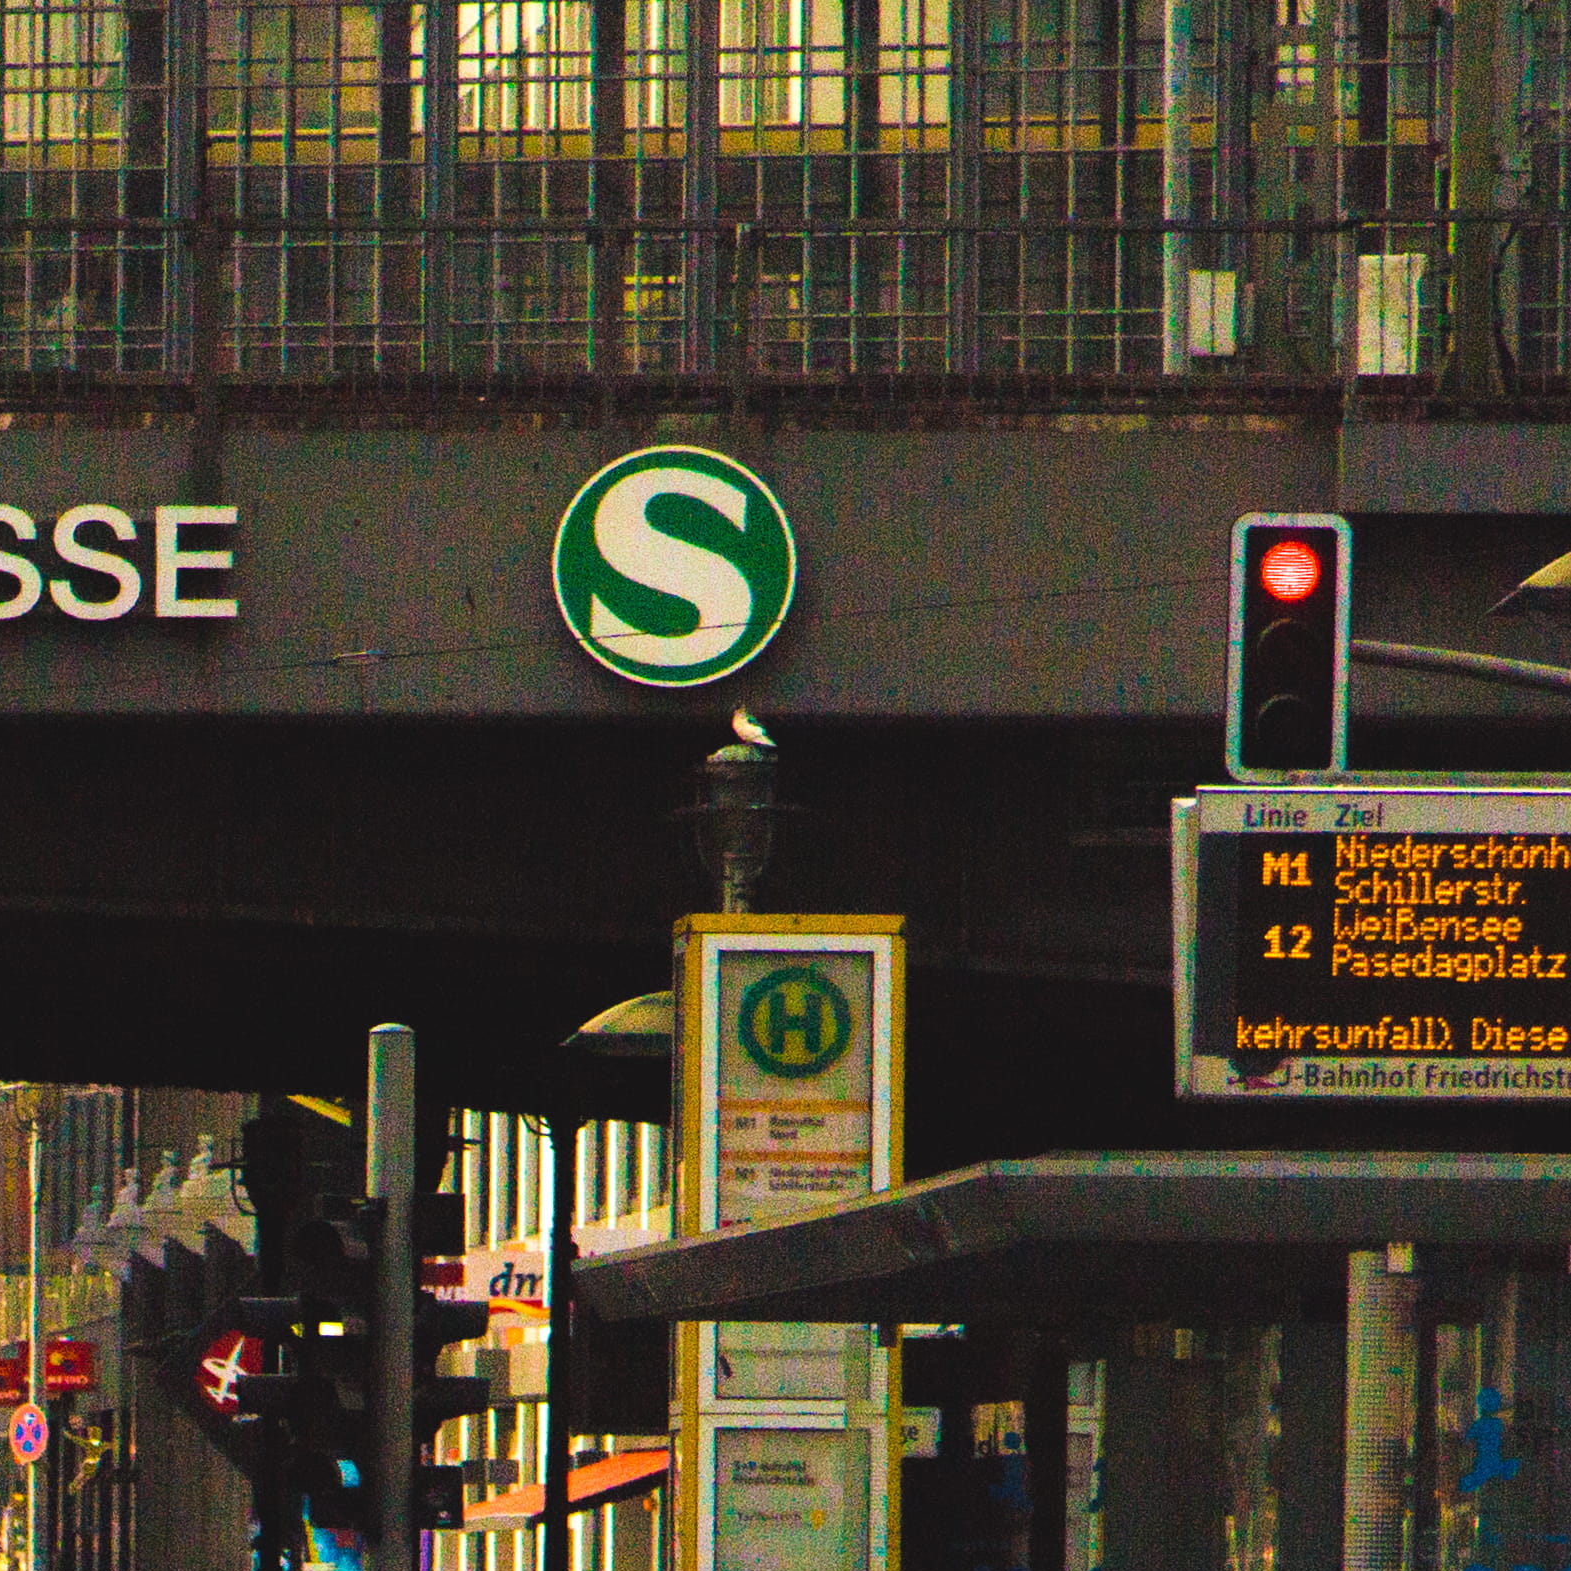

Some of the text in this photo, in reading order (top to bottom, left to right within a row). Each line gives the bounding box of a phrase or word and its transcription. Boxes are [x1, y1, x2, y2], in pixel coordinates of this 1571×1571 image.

[591, 466, 752, 667] S
[1243, 803, 1384, 828] Linie Ziel
[1262, 851, 1312, 886] M1
[1334, 871, 1526, 905] Schillerstr.
[1263, 907, 1523, 959] 12 Weißensee
[1331, 945, 1567, 982] Pasedagplatz
[1471, 1017, 1570, 1051] Diese
